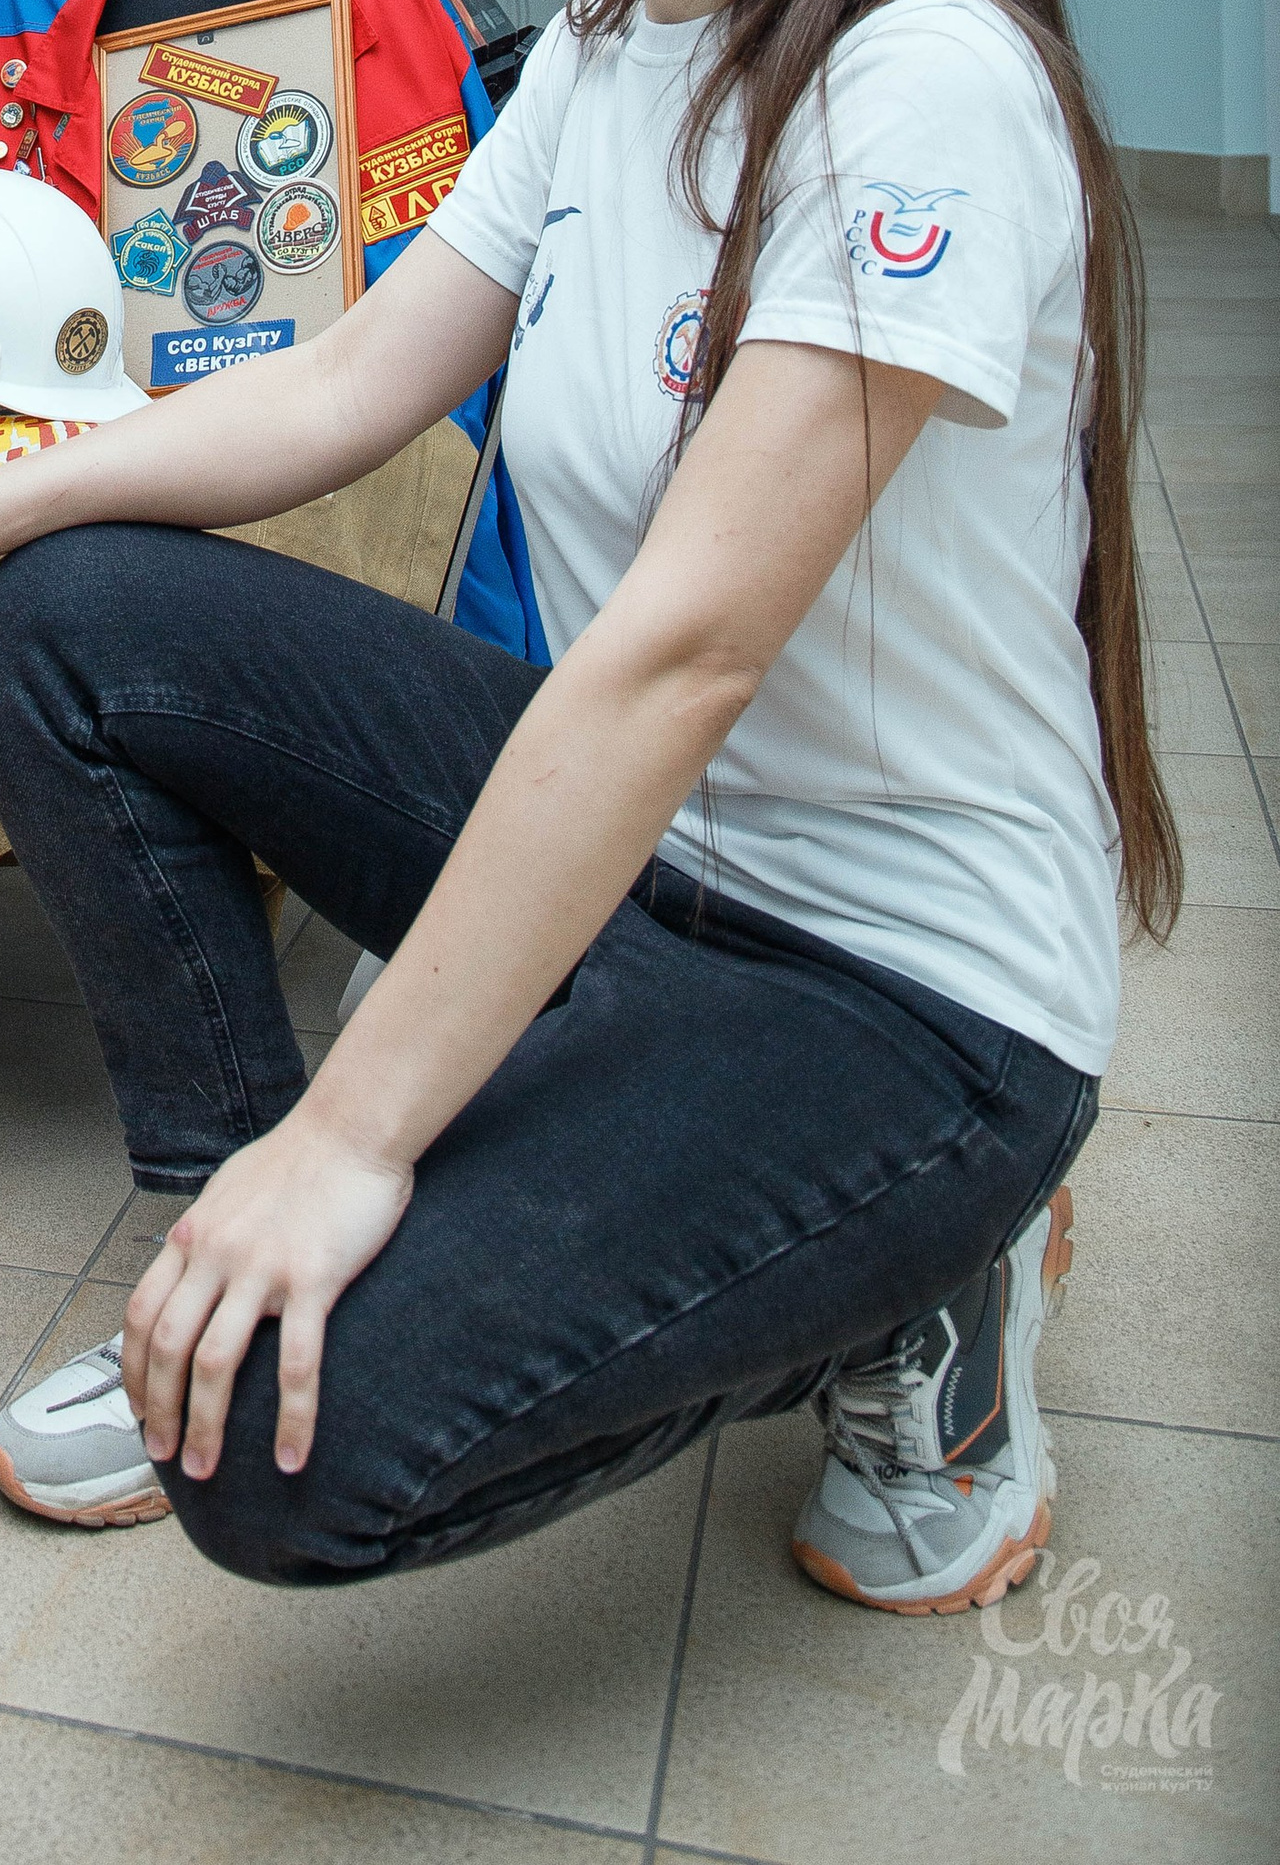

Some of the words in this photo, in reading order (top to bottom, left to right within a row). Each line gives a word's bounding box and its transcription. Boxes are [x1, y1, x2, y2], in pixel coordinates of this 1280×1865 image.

[161, 51, 231, 80] Студенческий
[231, 73, 261, 91] отряд
[167, 66, 244, 100] КУЗБАСС
[268, 97, 302, 108] ДЕНЧЕСКИЕ
[359, 132, 433, 171] туденческий
[434, 124, 463, 139] отряд
[278, 158, 306, 175] РСО
[369, 138, 458, 184] КУЗБАСС
[135, 167, 171, 180] КУЗБАСС
[196, 209, 240, 229] ШТАБ
[269, 222, 329, 244] АВЕРС
[277, 247, 289, 256] СО
[206, 296, 247, 318] ДРУЖБА
[167, 337, 207, 355] ССО
[212, 329, 282, 353] КузГТУ
